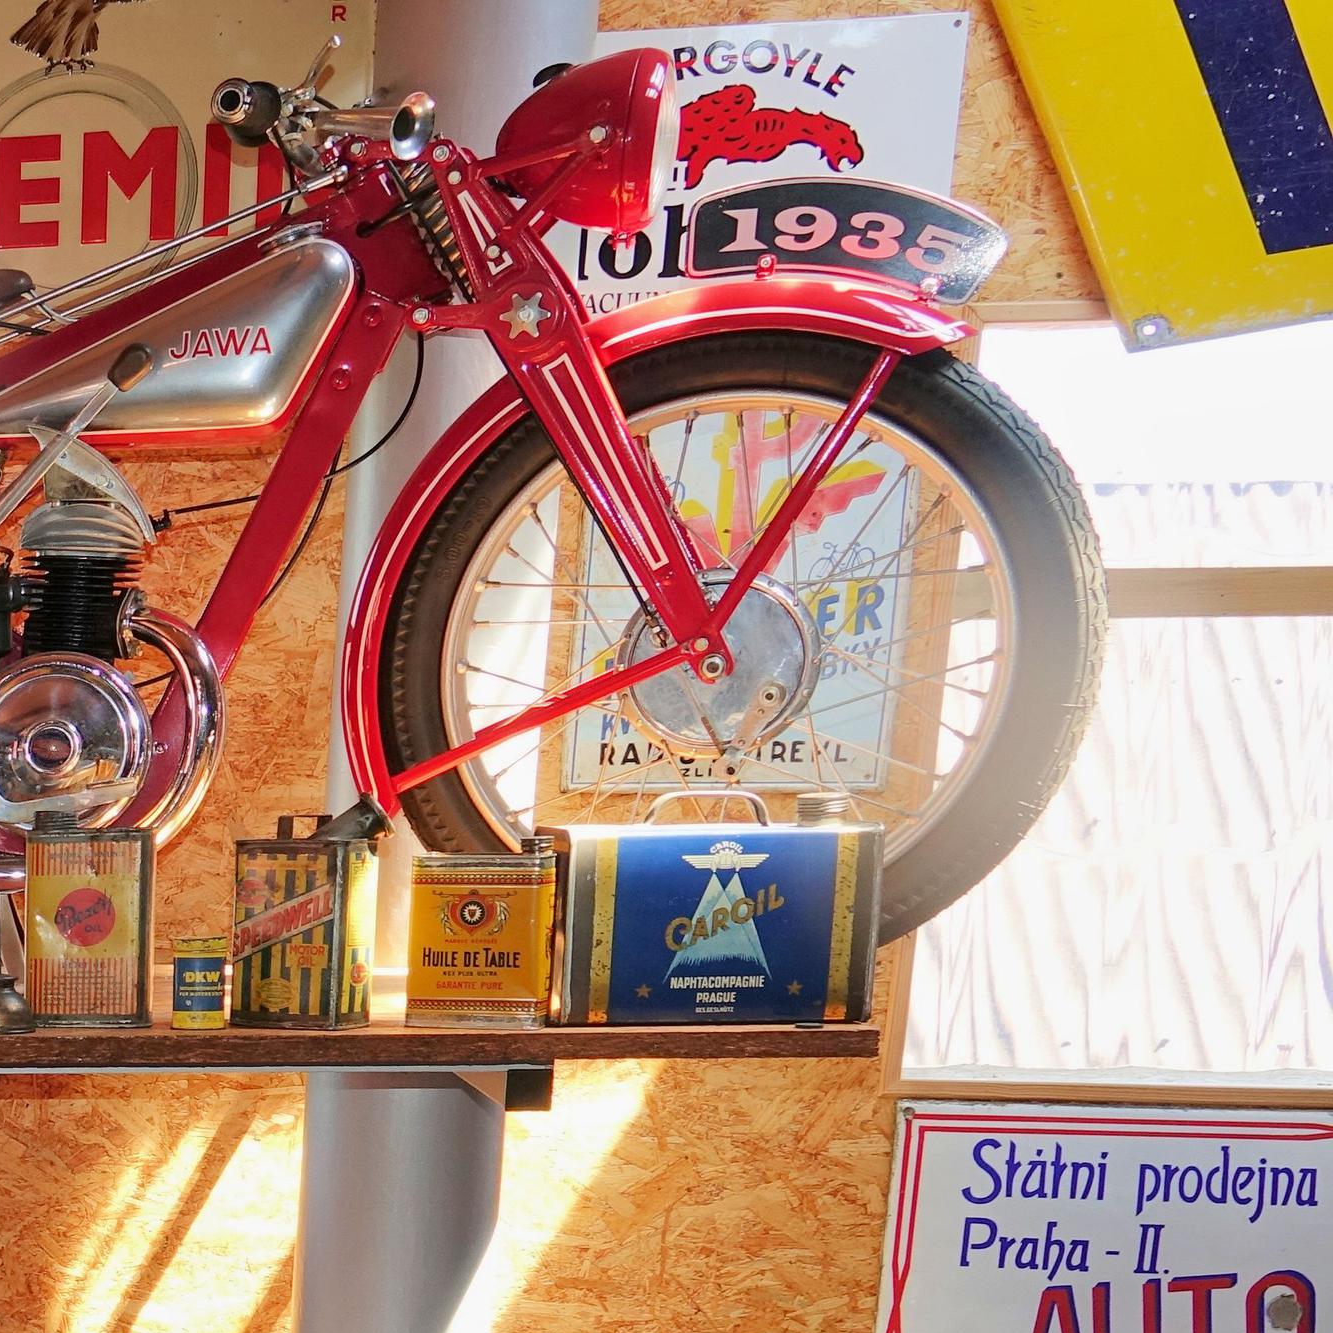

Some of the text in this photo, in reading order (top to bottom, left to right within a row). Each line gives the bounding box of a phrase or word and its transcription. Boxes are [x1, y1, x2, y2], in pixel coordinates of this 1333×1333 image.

[673, 39, 856, 98] RGOYLE
[718, 203, 965, 274] 1935
[168, 325, 275, 361] JAWA
[709, 840, 744, 854] CAROIL
[233, 890, 332, 957] SPEEDWELL
[664, 883, 785, 952] CAROIL
[289, 945, 326, 956] MOTOR
[297, 956, 315, 966] OIL
[422, 947, 520, 968] HUILE DE TABLE
[184, 971, 220, 983] DKW
[436, 980, 503, 990] GARANTIE PURE
[670, 975, 765, 989] NAPHTACOMPAGNIE
[696, 992, 736, 1003] PRAGUE
[1136, 1145, 1318, 1223] prodejna
[959, 1216, 1090, 1281] Praha
